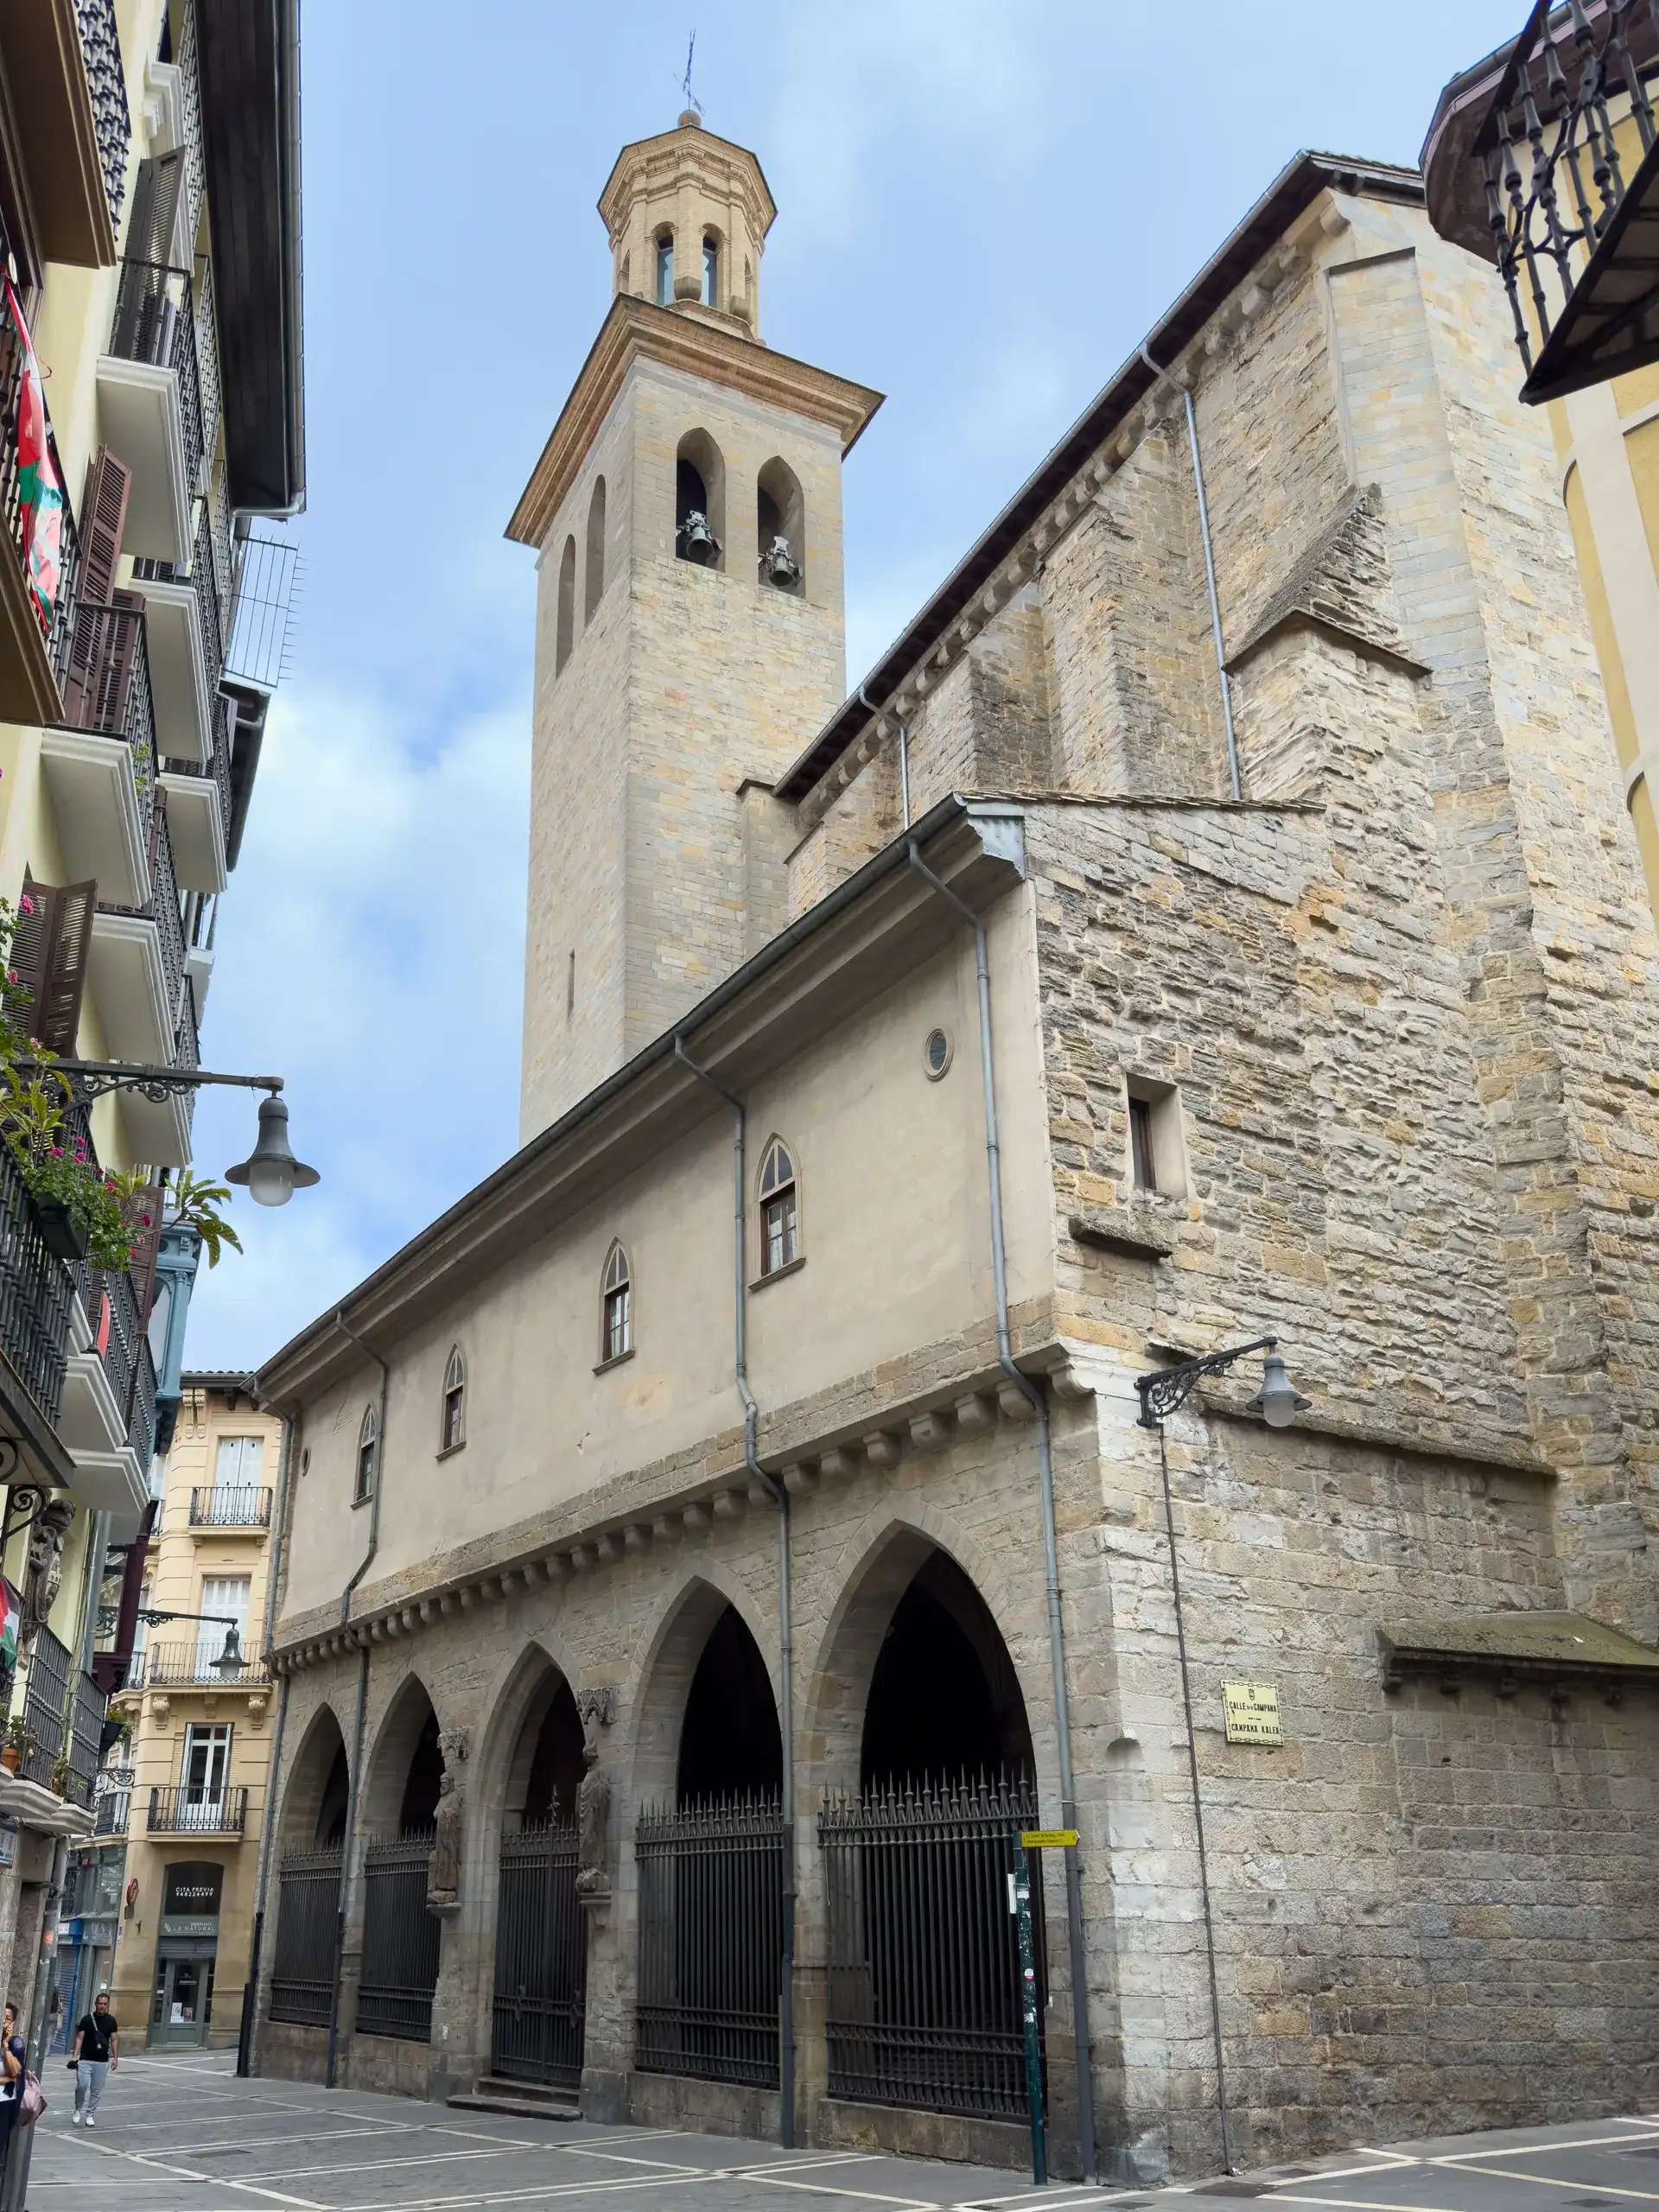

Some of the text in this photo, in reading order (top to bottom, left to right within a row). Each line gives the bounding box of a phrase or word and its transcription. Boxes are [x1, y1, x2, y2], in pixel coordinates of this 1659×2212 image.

[1230, 1701, 1246, 1710] CALLE
[1253, 1703, 1277, 1713] CAMPANA
[1231, 1723, 1280, 1734] CAMPANA KALEA
